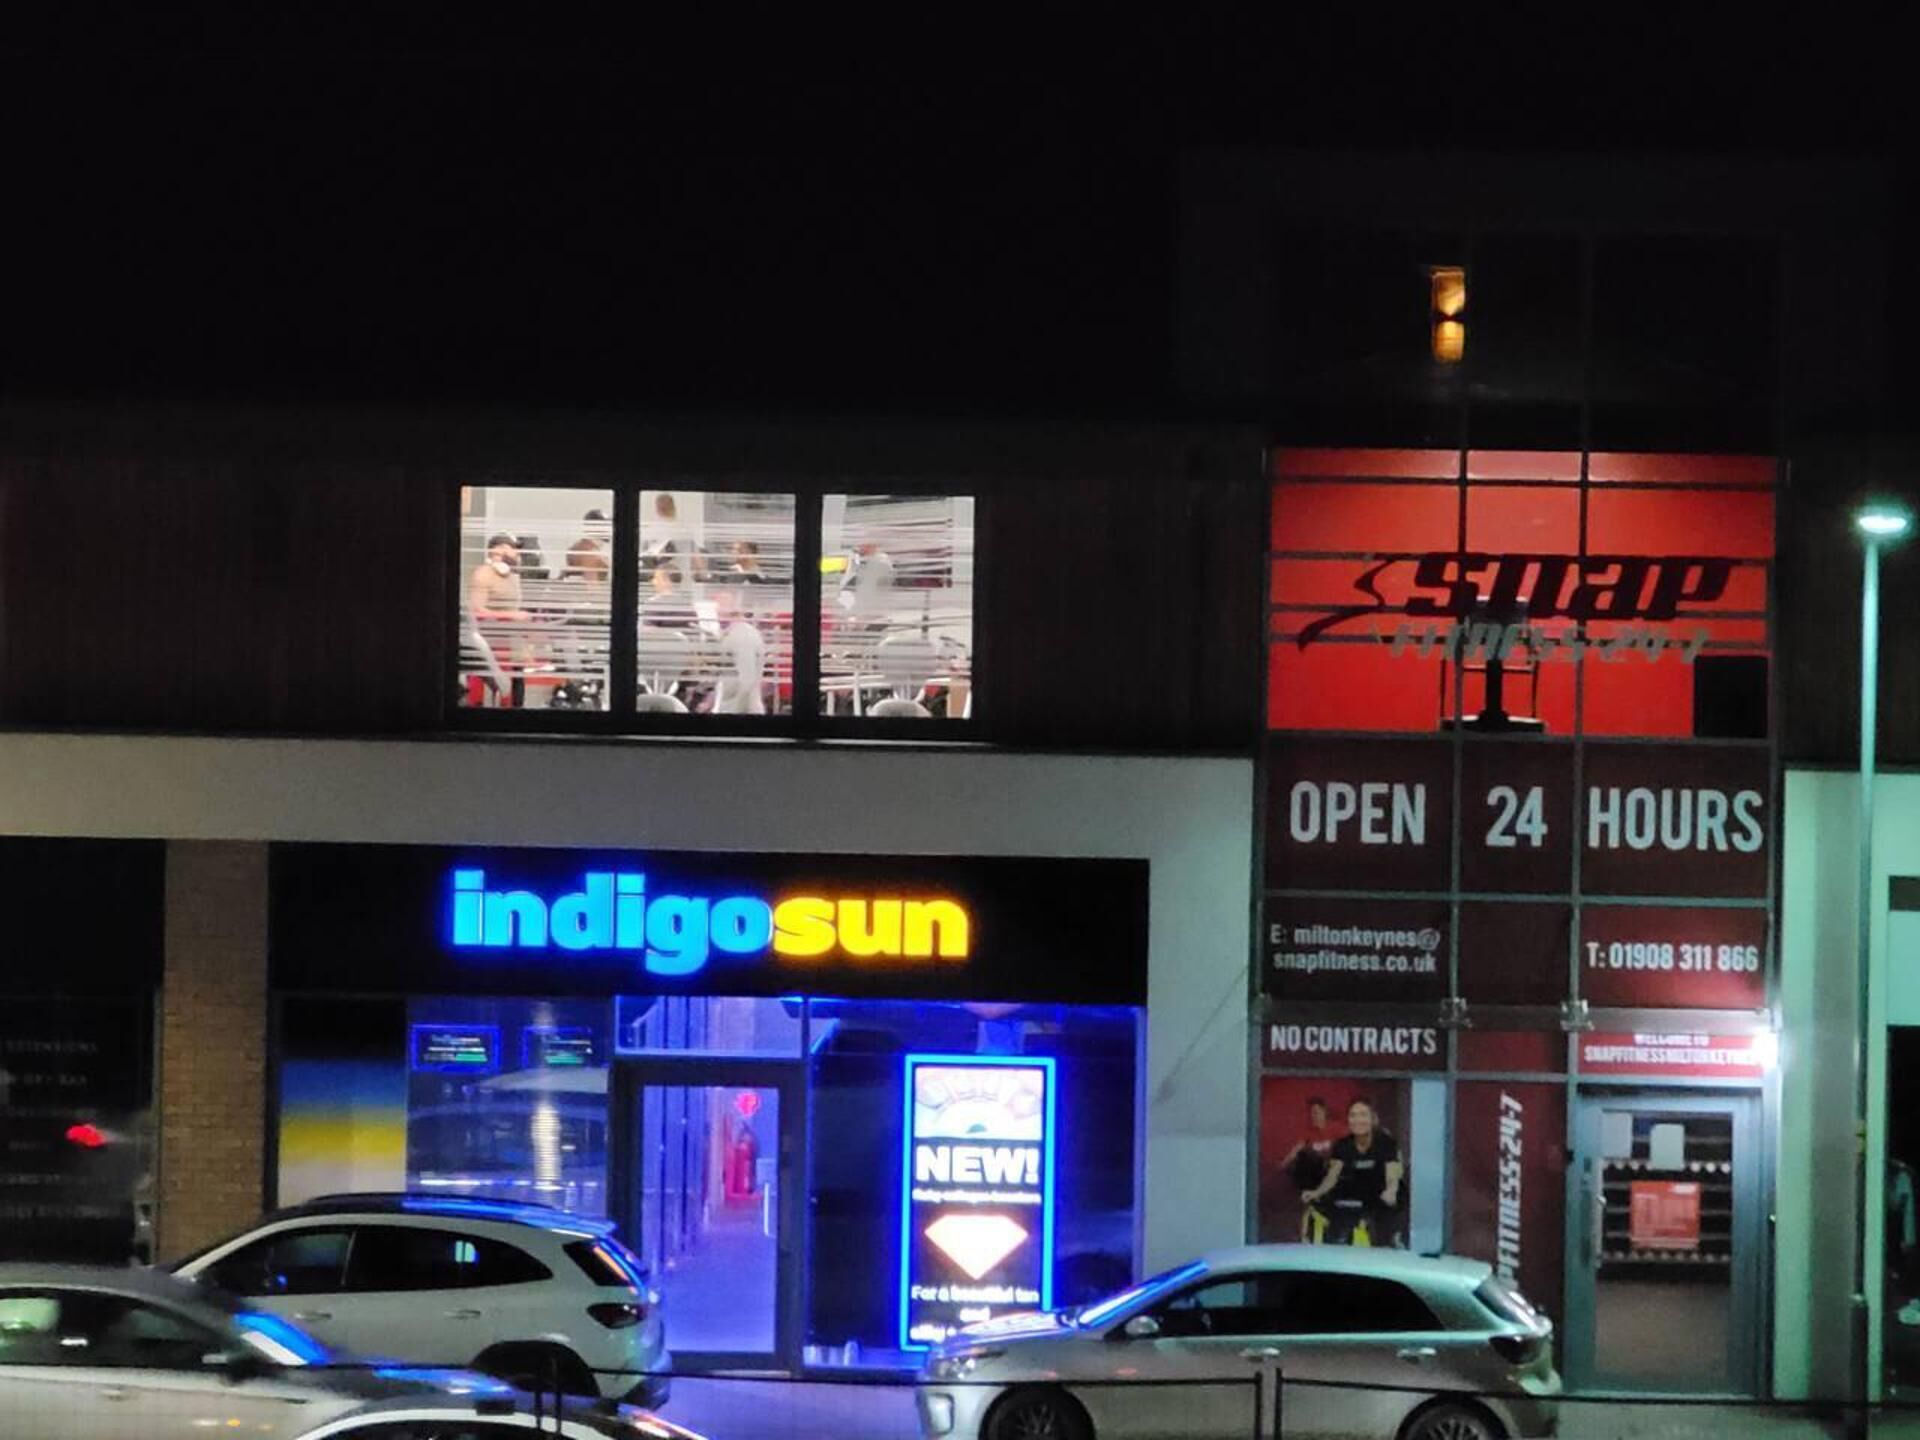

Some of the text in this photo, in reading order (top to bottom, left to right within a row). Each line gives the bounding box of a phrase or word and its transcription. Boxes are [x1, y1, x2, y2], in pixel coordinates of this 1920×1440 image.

[1290, 781, 1764, 851] OPEN 24 HOURS
[453, 869, 969, 976] indigosun
[1586, 941, 1759, 972] T: 01908 311 866
[1271, 1025, 1437, 1055] NO CONTRACTS
[916, 1145, 1040, 1184] NEW!
